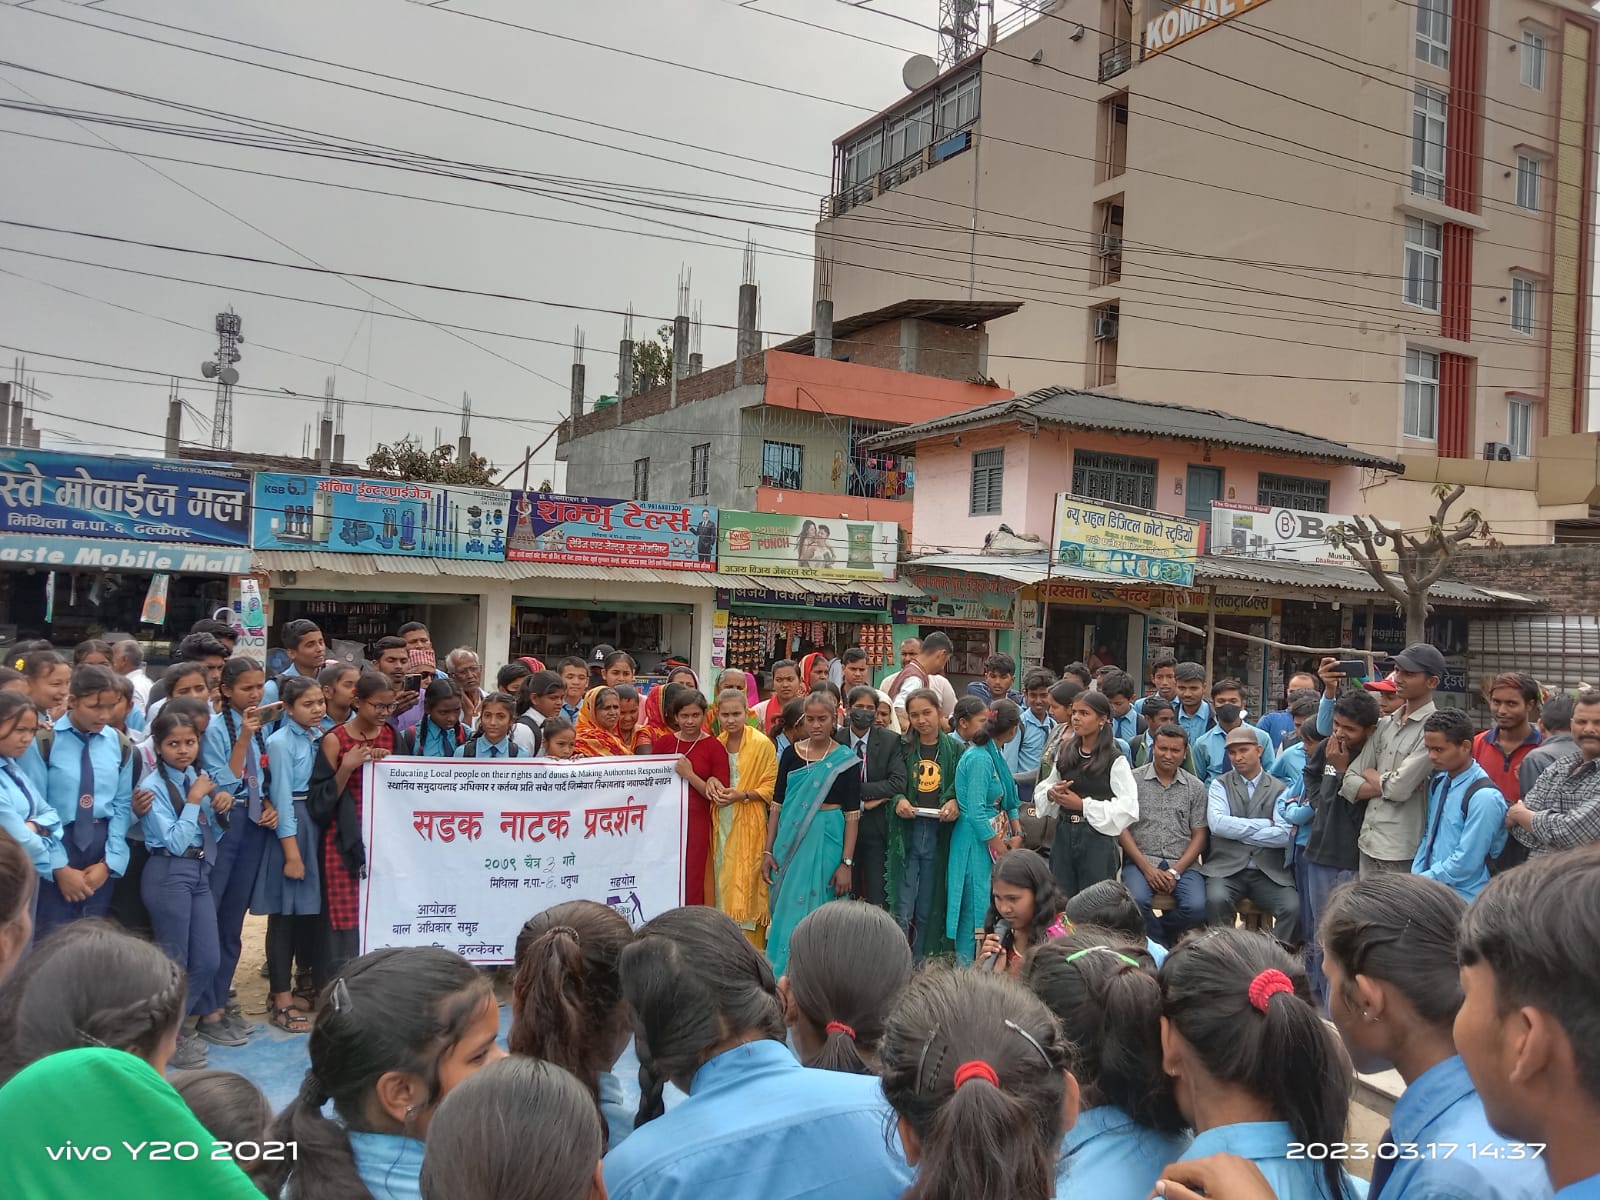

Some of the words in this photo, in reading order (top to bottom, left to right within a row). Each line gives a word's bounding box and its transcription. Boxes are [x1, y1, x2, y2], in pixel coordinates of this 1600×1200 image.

[1145, 0, 1236, 54] KOMAL
[0, 463, 46, 509] स्ते
[188, 487, 246, 522] मल
[264, 484, 286, 495] KSB
[8, 513, 67, 529] मिथिला
[1066, 506, 1081, 526] न्यू
[1082, 509, 1106, 529] राहुल
[1108, 511, 1142, 533] डिजिटल
[1143, 519, 1164, 538] फोटो
[1165, 524, 1193, 544] स्टुडियो
[757, 537, 790, 551] PUNCH
[0, 546, 64, 564] aste
[74, 547, 173, 570] Mobile
[180, 553, 244, 574] Mall
[725, 565, 747, 574] अजय
[749, 564, 771, 575] विजय
[773, 565, 799, 576] जेनरल
[800, 568, 819, 577] स्टोर
[1359, 626, 1407, 640] Mngala
[390, 768, 429, 781] Educating
[430, 769, 452, 778] Local
[453, 769, 479, 780] people
[492, 770, 509, 779] their
[511, 770, 532, 780] rights
[533, 771, 547, 779] and
[548, 770, 569, 779] duties
[570, 770, 577, 778] &
[578, 768, 601, 779] Making
[604, 766, 637, 777] Authorities
[637, 765, 672, 776] Responsible
[387, 779, 415, 791] स्थानिय
[416, 782, 457, 793] समुदायलाइ
[459, 780, 489, 791] अधिकार
[490, 783, 495, 791] र
[497, 780, 518, 792] कर्तव्य
[520, 780, 534, 792] प्रति
[535, 781, 553, 792] सचेत
[412, 810, 484, 844] सडक
[499, 810, 571, 843] नाटक
[583, 795, 648, 840] प्रदर्शन
[484, 857, 517, 871] २०७९
[524, 854, 542, 869] चैत्र
[562, 851, 577, 867] गते
[490, 876, 519, 889] मिथिला
[610, 873, 636, 887] सहयोग
[418, 900, 457, 915] आयोजक
[417, 920, 453, 934] अधिकार
[457, 921, 479, 936] समुह
